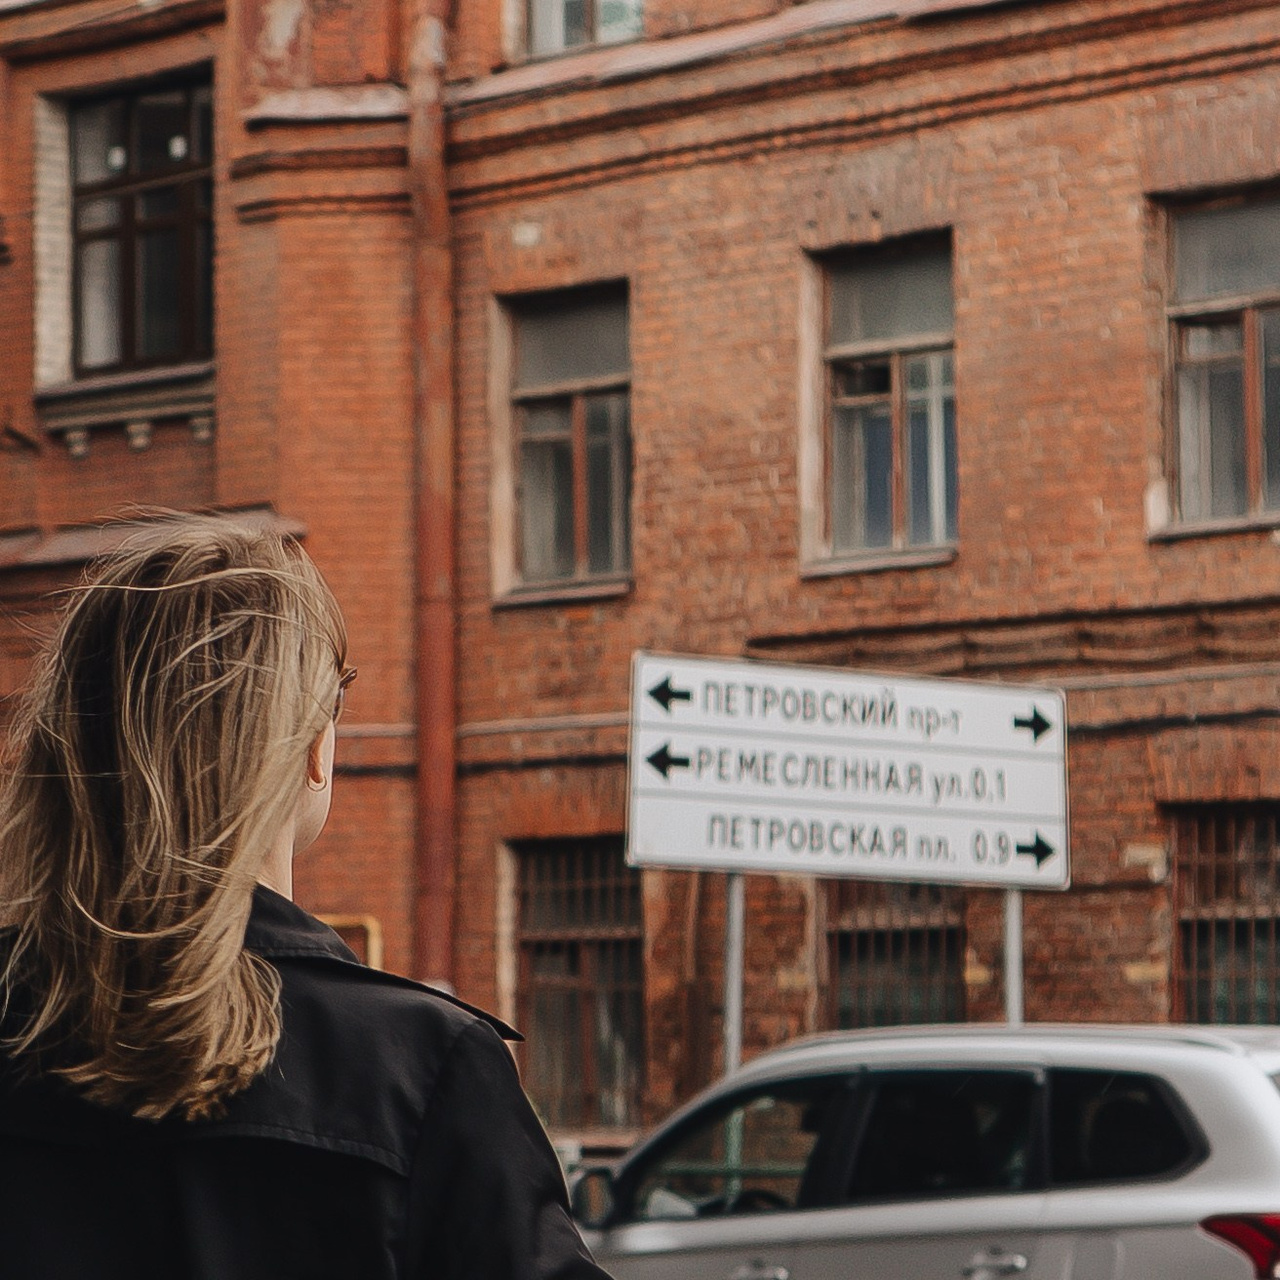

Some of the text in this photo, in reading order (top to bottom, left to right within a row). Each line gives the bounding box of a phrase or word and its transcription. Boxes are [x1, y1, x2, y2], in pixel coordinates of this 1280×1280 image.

[704, 681, 962, 740] ПЕТРОВСКИЙ пр-т
[696, 747, 924, 795] РЕМЕСЛЕННАЯ
[707, 815, 909, 860] ПЕТРОВСКАЯ
